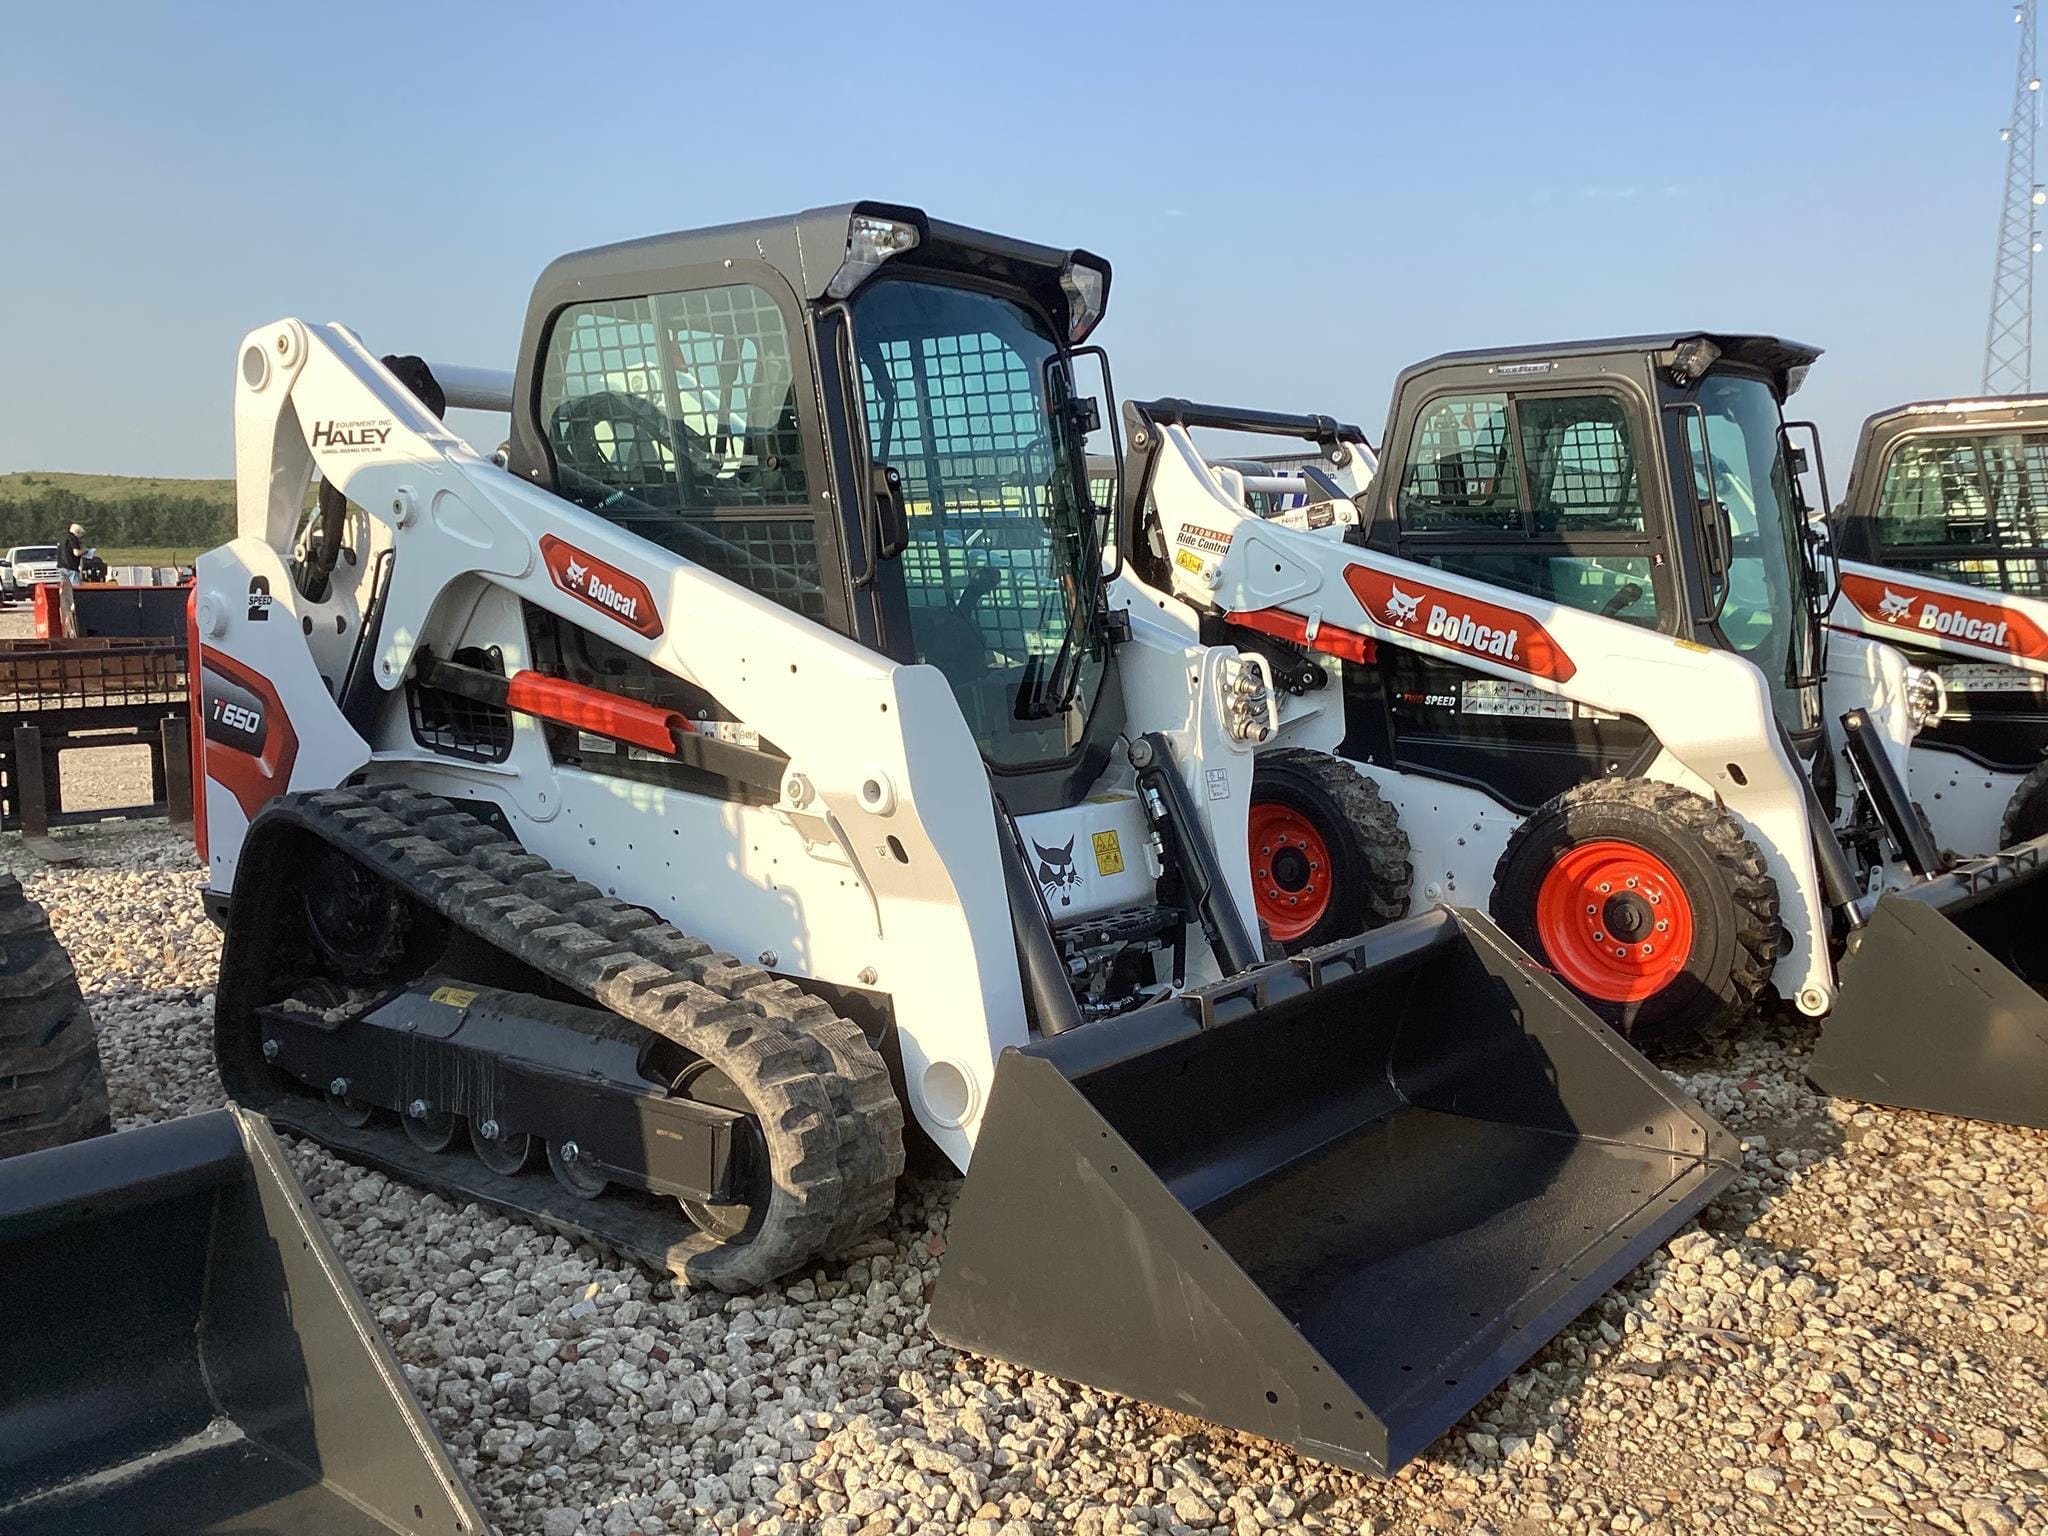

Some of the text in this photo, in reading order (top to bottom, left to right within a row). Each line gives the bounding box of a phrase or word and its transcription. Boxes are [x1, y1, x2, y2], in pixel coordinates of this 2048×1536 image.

[312, 420, 392, 447] HALEY
[335, 420, 376, 428] EQUIPMENT
[1176, 533, 1231, 555] Ride Control
[1182, 524, 1231, 543] AUTOMATIC
[248, 596, 272, 606] SPEED
[588, 574, 637, 620] Bobcat
[1426, 605, 1518, 661] Bobcat
[1918, 603, 2008, 647] Bobcat
[1403, 693, 1456, 707] TWO SPEED
